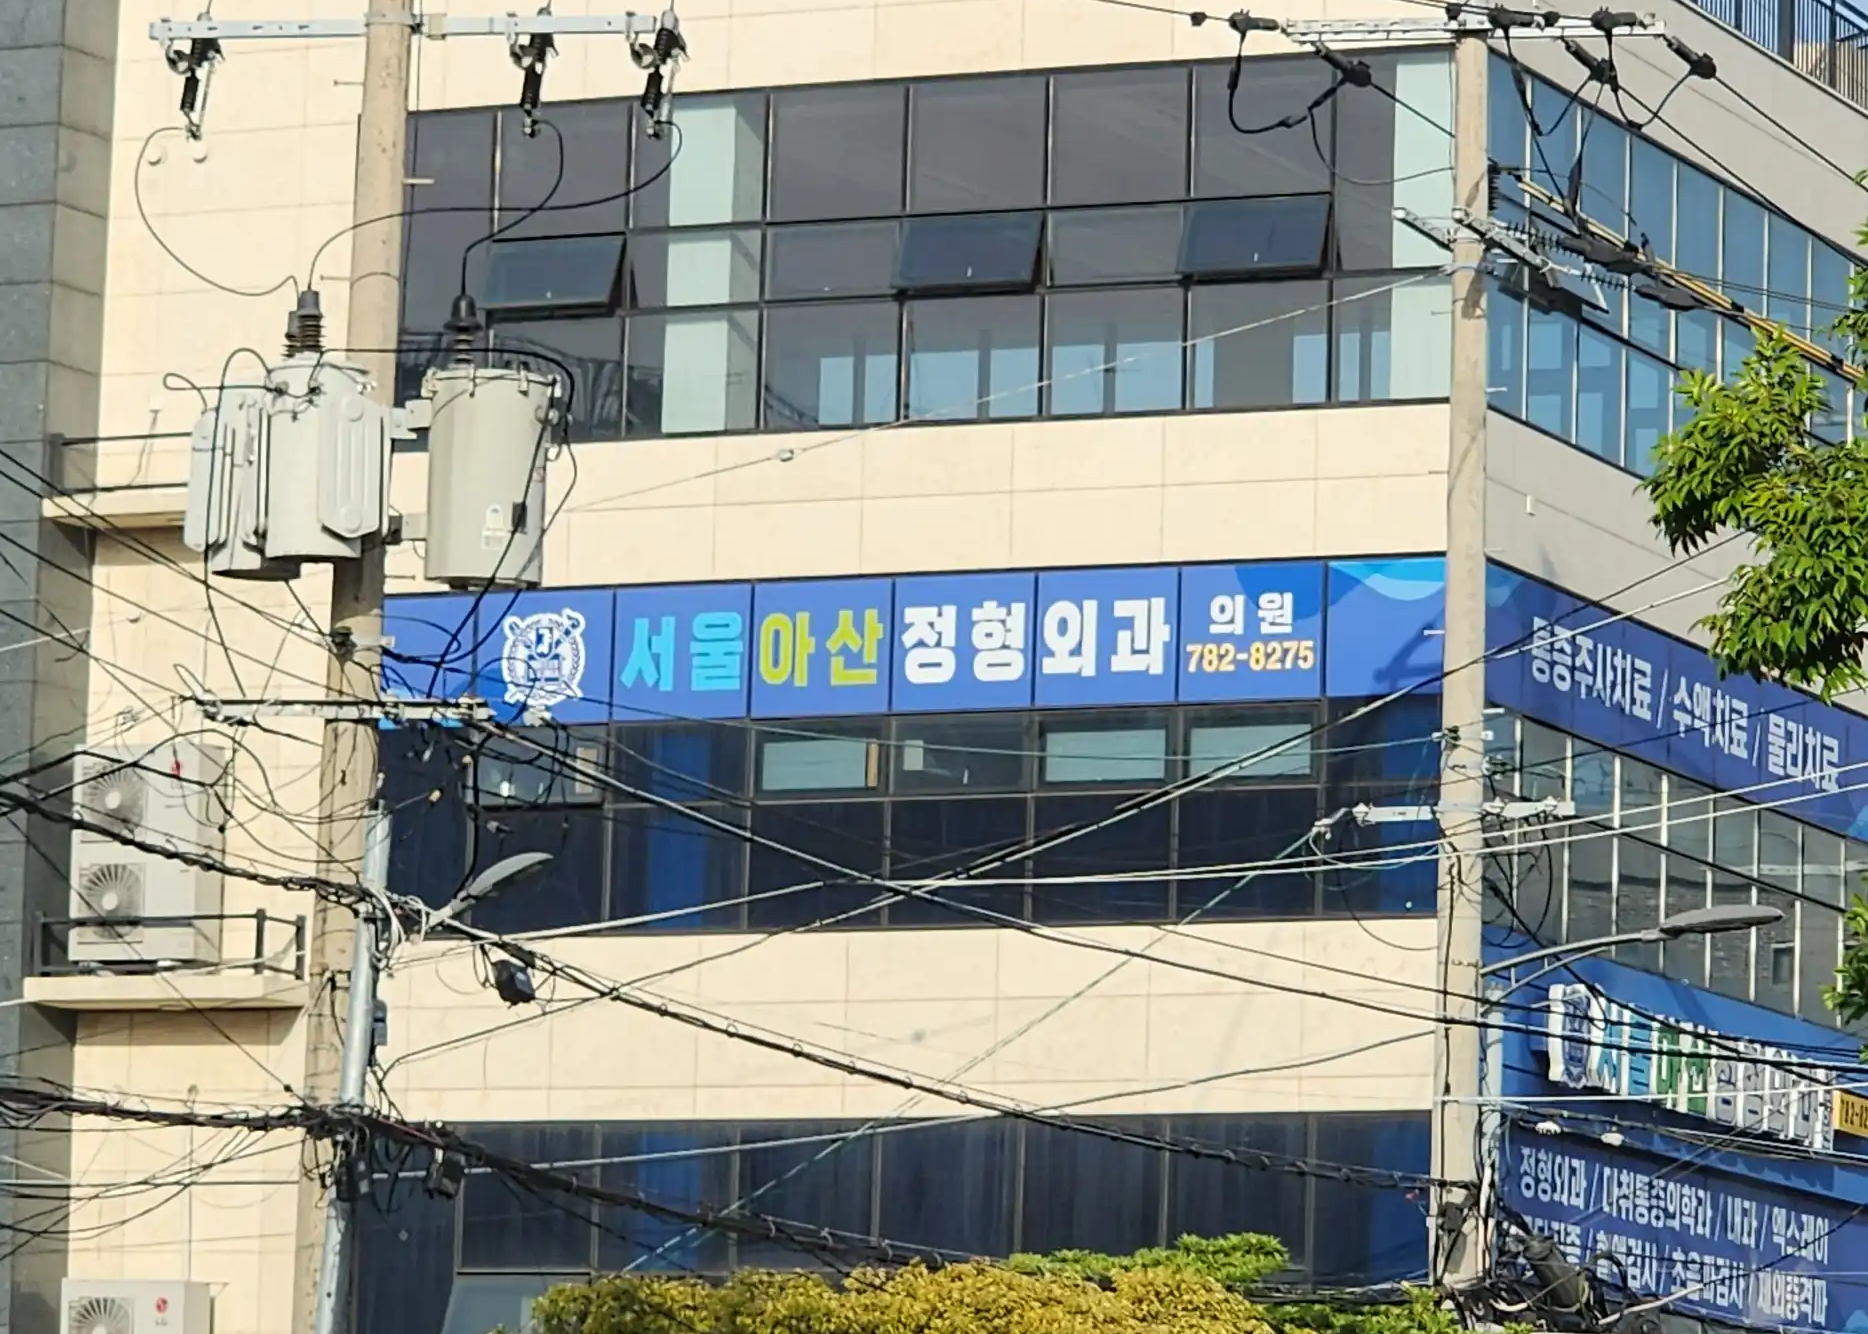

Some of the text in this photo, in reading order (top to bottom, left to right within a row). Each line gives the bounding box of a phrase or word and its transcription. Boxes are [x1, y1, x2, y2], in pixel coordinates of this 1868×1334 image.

[1186, 641, 1315, 673] 782-8275
[1767, 713, 1840, 792] 물리치료
[1519, 1145, 1587, 1210] 정형외과
